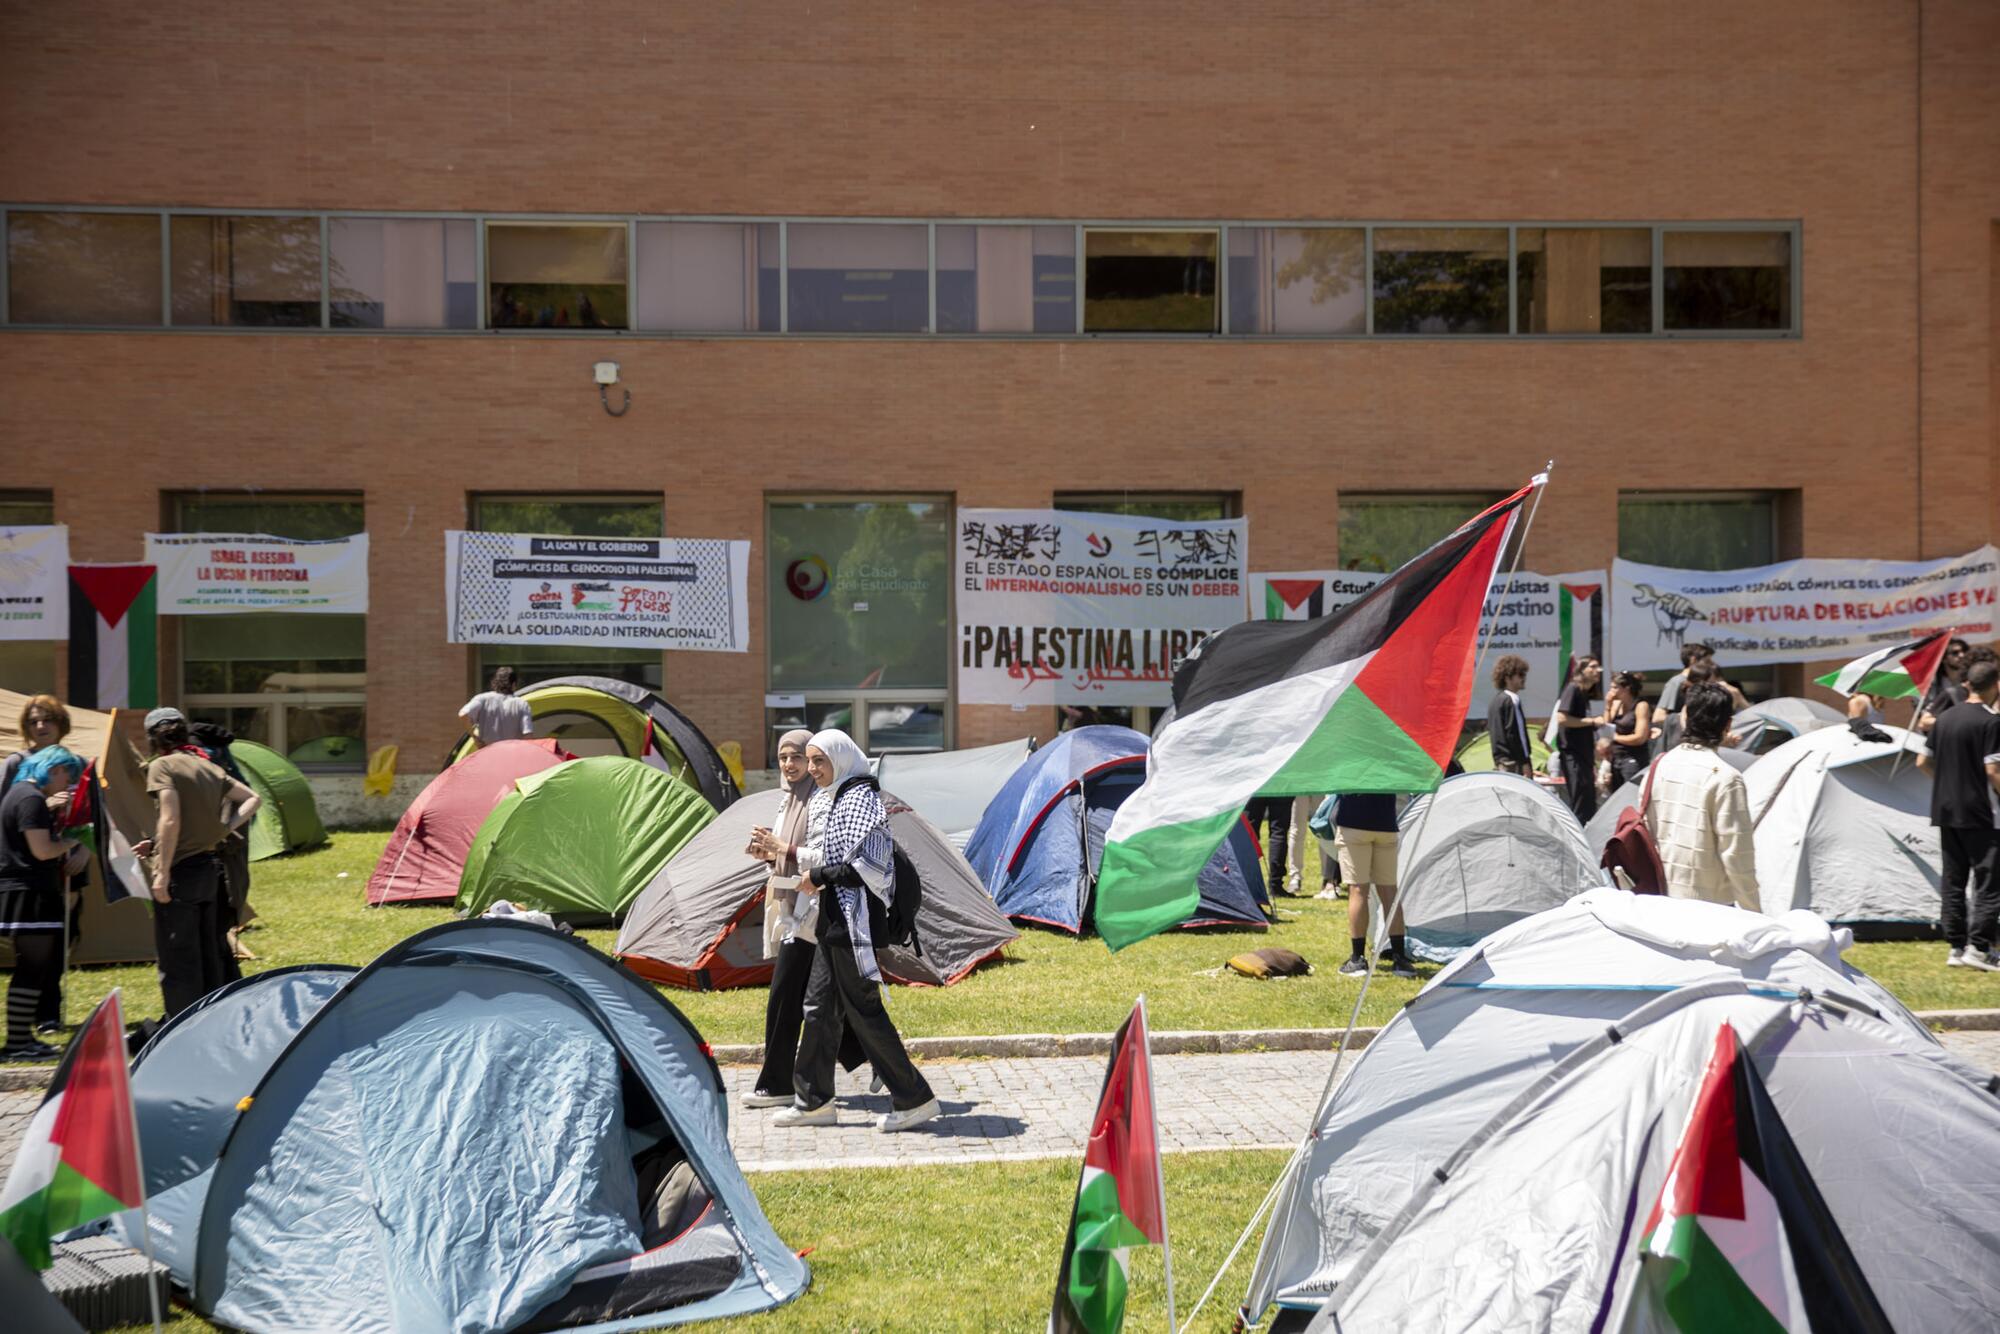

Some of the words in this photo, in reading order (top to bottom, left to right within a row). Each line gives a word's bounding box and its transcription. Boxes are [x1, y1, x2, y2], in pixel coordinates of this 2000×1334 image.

[541, 541, 556, 550] LA
[556, 542, 576, 550] UCM
[578, 542, 585, 550] Y
[587, 542, 598, 551] EL
[599, 543, 649, 552] GOBIERNO
[197, 567, 210, 580] LA
[553, 563, 570, 572] DEL
[571, 564, 625, 574] GENOCIDIO
[626, 565, 639, 575] EN
[641, 566, 693, 576] PALESTINA!
[860, 564, 897, 578] Casa
[965, 561, 983, 574] EL
[987, 562, 1051, 577] ESTADO
[1056, 563, 1130, 579] ESPAÑOL
[1134, 567, 1153, 580] ES
[1157, 564, 1239, 580] CÓMPLICE
[861, 579, 928, 591] Estudiante
[965, 577, 981, 591] EL
[985, 578, 1142, 596] INTERNACIONALISMO
[1146, 583, 1164, 596] ES
[1167, 583, 1189, 596] UN
[1192, 583, 1239, 597] DEBER
[1681, 584, 1743, 594] GOBIERNO
[1746, 580, 1794, 593] ESPAÑOL
[1797, 578, 1856, 590] CÓMPLICE
[1858, 579, 1881, 589] DEL
[1710, 603, 1810, 625] ¡RUPTURA
[1814, 602, 1840, 620] DE
[1843, 591, 1969, 620] RELACIONES
[540, 612, 596, 620] ESTUDIANTES
[598, 613, 637, 621] DECIMOS
[471, 624, 504, 637] ¡VIVA
[507, 625, 523, 635] LA
[527, 625, 609, 636] SOLIDARIDAD
[612, 626, 716, 639] INTERNACIONAL!
[1761, 637, 1776, 649] de
[1779, 635, 1849, 649] Estudiantes
[1071, 644, 1174, 691] لسطين
